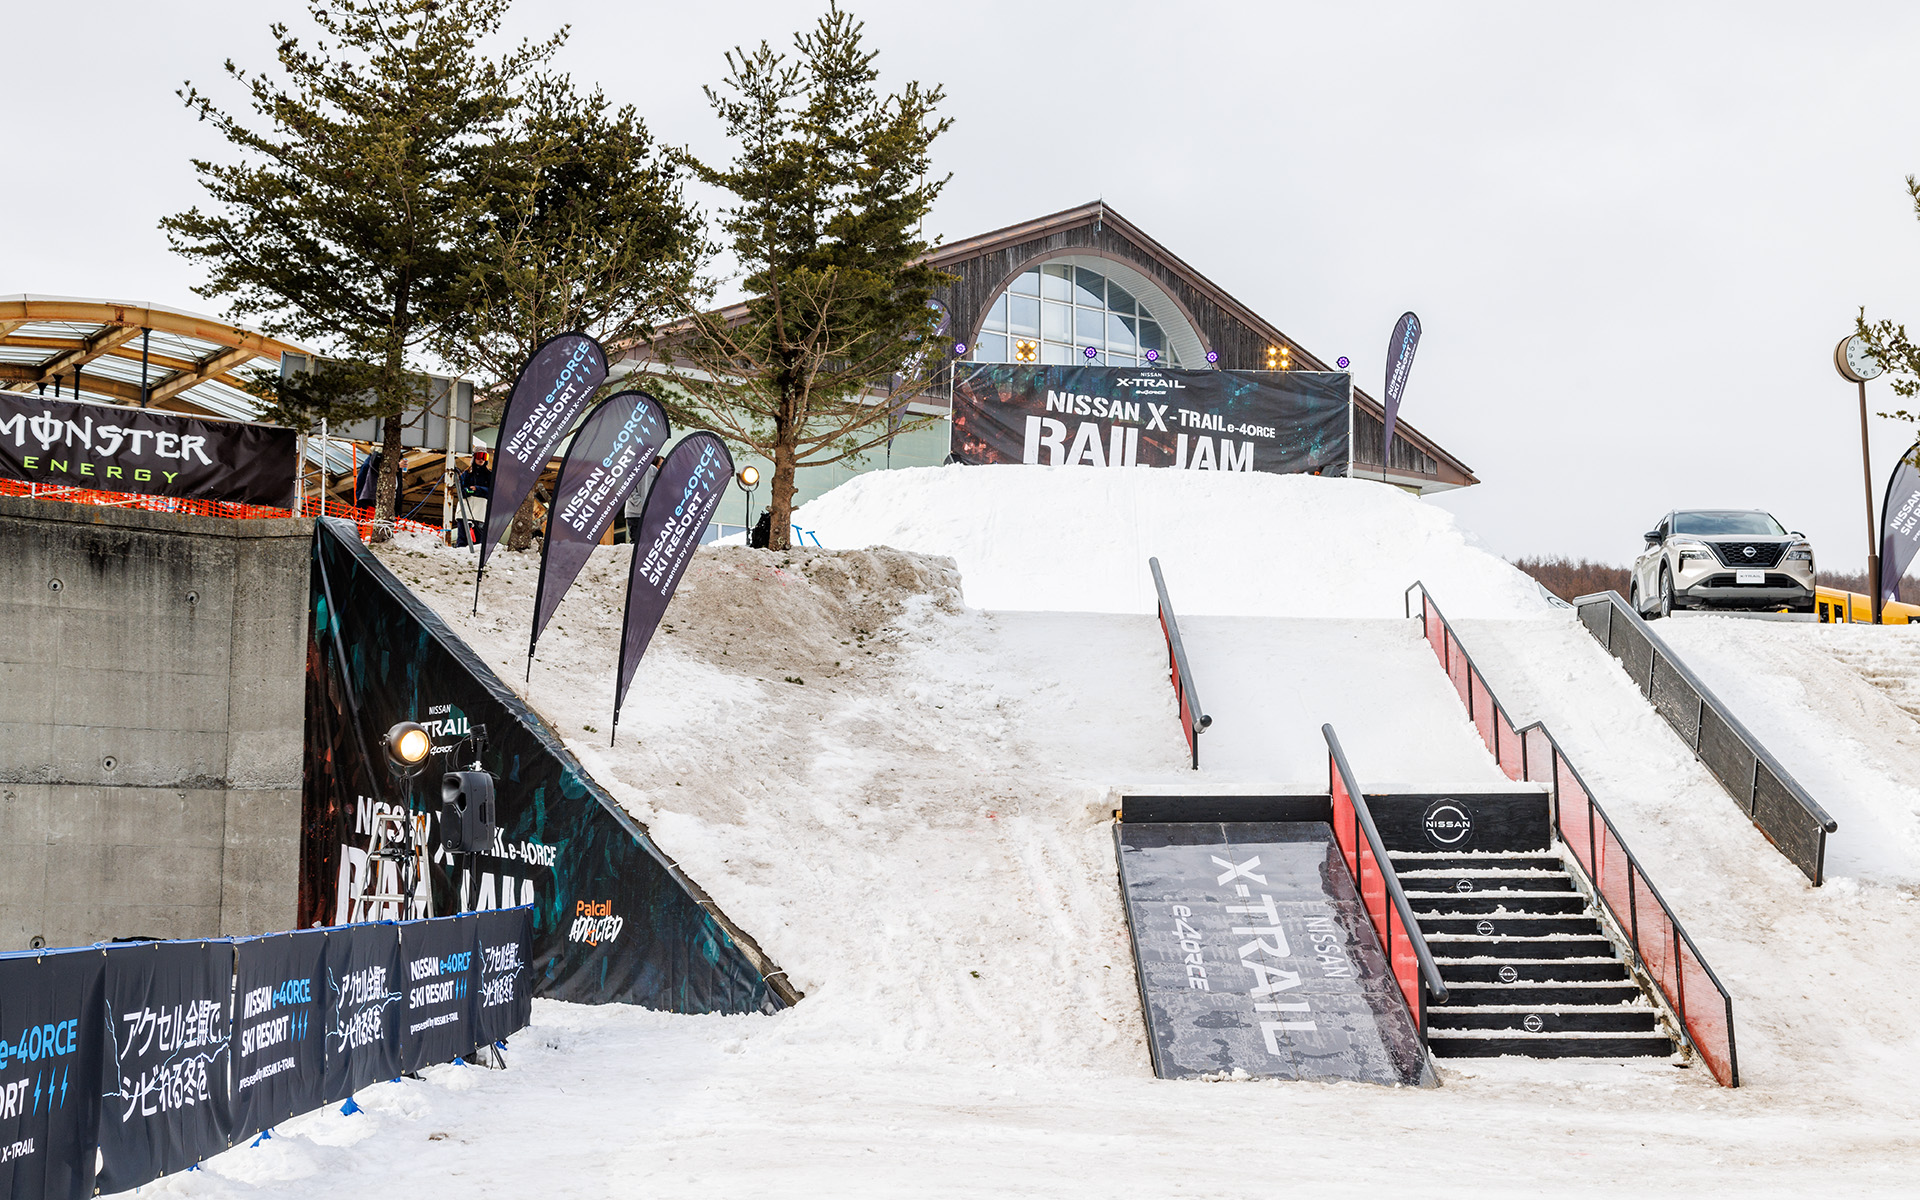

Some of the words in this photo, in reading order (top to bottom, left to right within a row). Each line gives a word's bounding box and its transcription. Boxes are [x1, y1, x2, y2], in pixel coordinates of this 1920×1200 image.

[506, 402, 548, 454] NISSAN
[545, 341, 590, 404] e-4ORCE
[1116, 378, 1186, 388] X-TRAIL
[517, 438, 538, 463] SKI
[533, 382, 577, 439] RESORT
[530, 438, 553, 472] presented
[551, 430, 559, 441] by
[558, 407, 575, 432] NISSAN
[574, 385, 594, 409] X-TRAIL
[1046, 390, 1140, 422] NISSAN
[1228, 423, 1276, 438] e-4ORCE
[560, 467, 605, 522] NISSAN
[602, 401, 649, 468] e-4ORCE
[1022, 415, 1150, 468] RAIL
[1169, 433, 1254, 472] JAM
[23, 456, 178, 484] ENERGY
[572, 504, 595, 532] SKI
[590, 445, 636, 506] RESORT
[586, 506, 612, 540] presented
[610, 497, 618, 507] by
[616, 472, 636, 497] NISSAN
[634, 447, 655, 473] X-TRAIL
[639, 516, 677, 578] NISSAN
[675, 444, 715, 517] e-4ORCE
[1890, 490, 1920, 529] NISSAN
[1901, 516, 1917, 536] SKI
[649, 557, 668, 586] SKI
[664, 492, 704, 558] RESORT
[660, 556, 682, 596] presented
[680, 547, 687, 558] by
[686, 520, 701, 548] NISSAN
[420, 717, 471, 738] TRAIL
[429, 704, 451, 715] NISSAN
[508, 841, 556, 866] e-4ORCE
[576, 900, 612, 916] Palcall
[410, 957, 439, 981] NISSAN
[1210, 855, 1318, 1056] X-TRAIL
[1303, 914, 1351, 979] NISSAN
[244, 986, 272, 1020] NISSAN
[272, 979, 311, 1009] e-4ORCE
[410, 986, 424, 1009] SKI
[426, 980, 454, 1004] RESORT
[0, 1018, 78, 1070] e-4ORCE
[242, 1024, 255, 1057] SKI
[257, 1015, 289, 1050] RESORT
[1, 1138, 35, 1163] X-TRAIL
